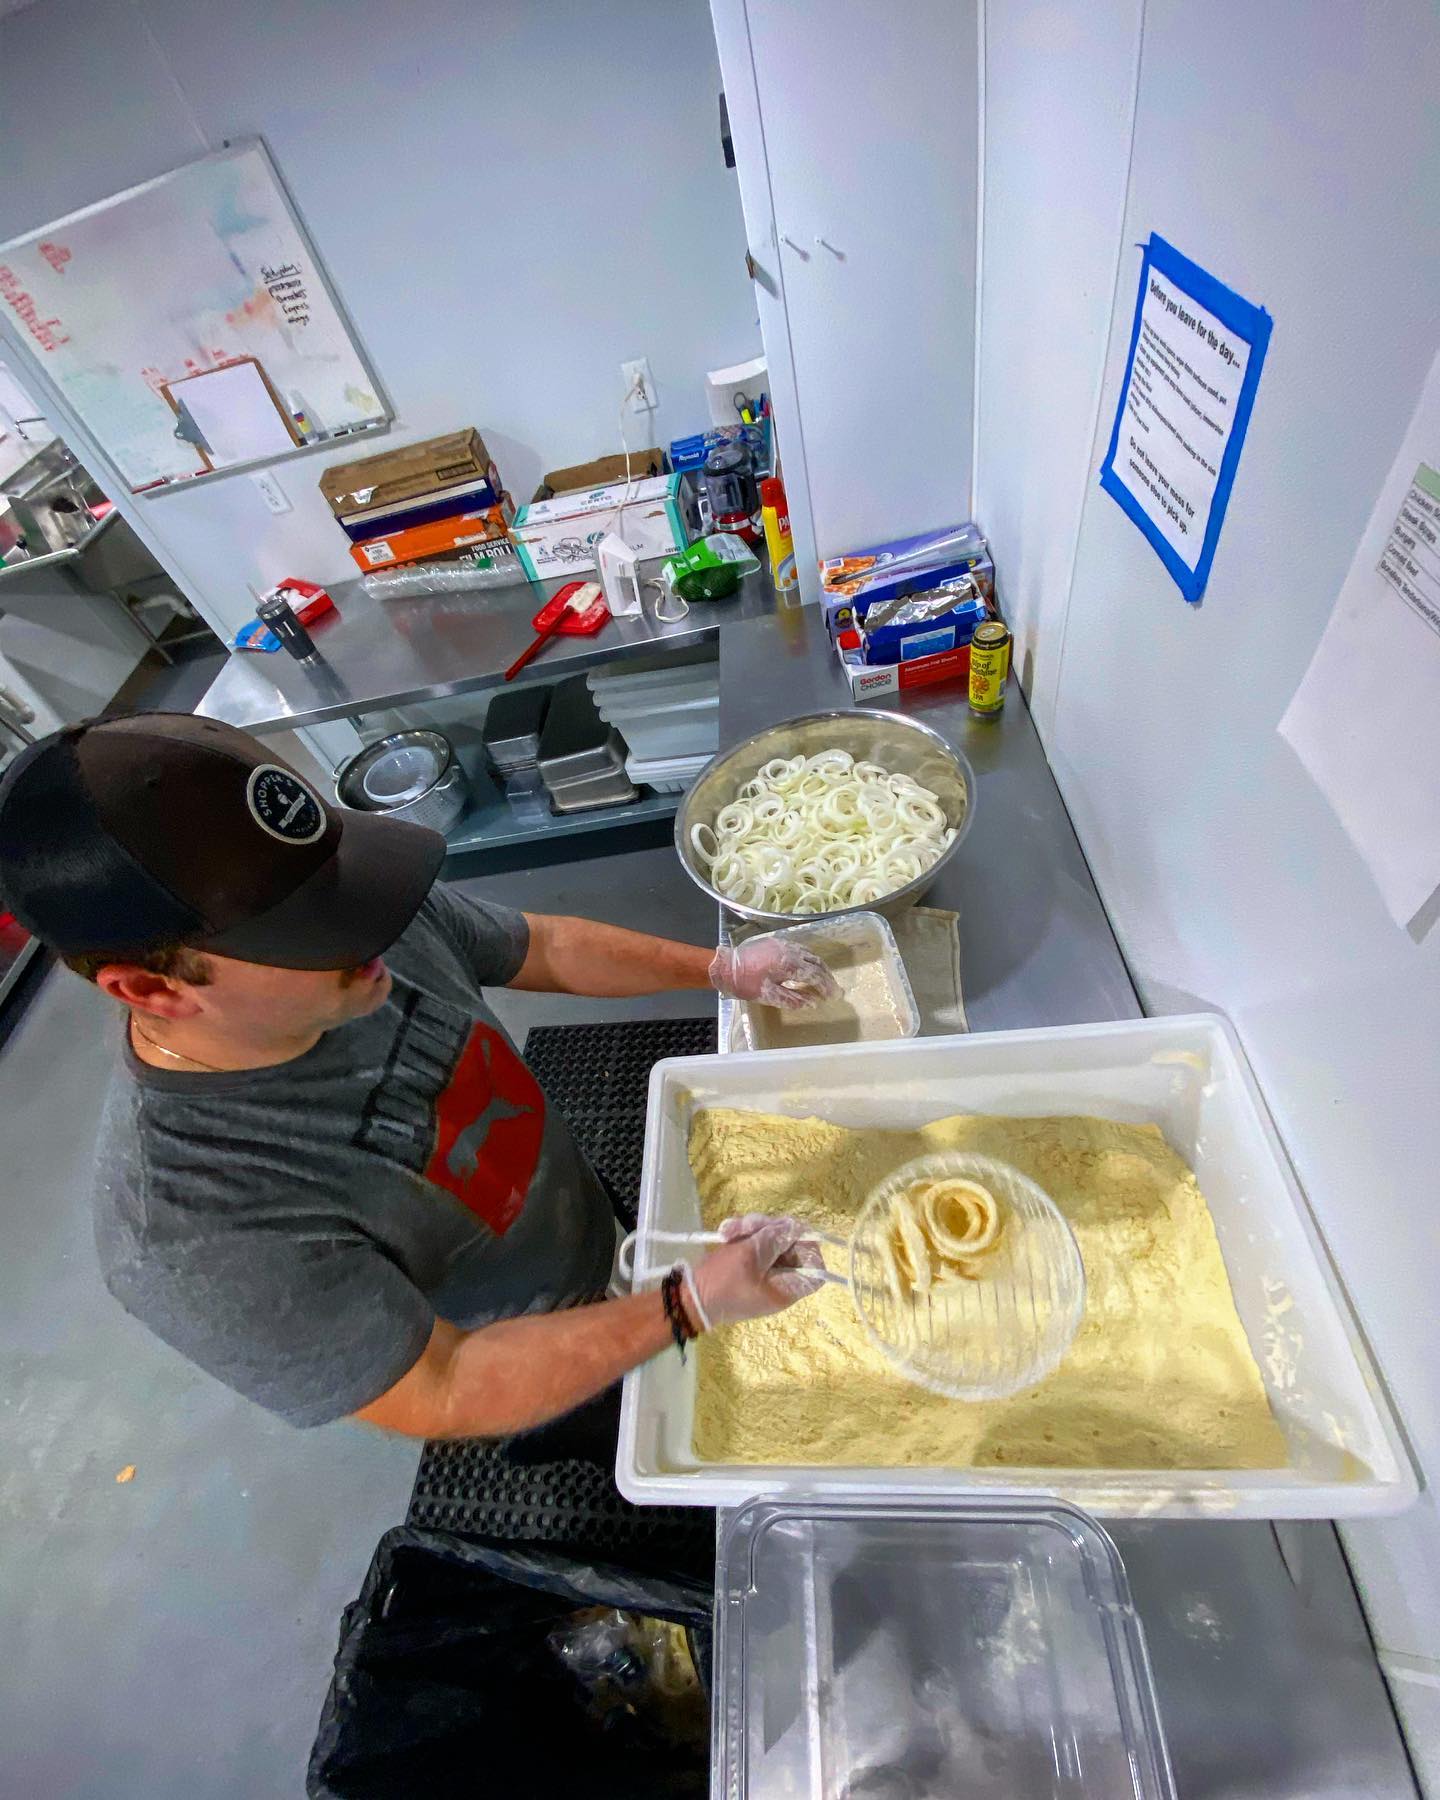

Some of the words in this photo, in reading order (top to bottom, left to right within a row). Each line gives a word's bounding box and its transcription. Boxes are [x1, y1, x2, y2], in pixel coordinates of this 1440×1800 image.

[1150, 279, 1166, 304] Before
[1165, 299, 1177, 315] you
[1178, 306, 1196, 330] leave
[1197, 321, 1207, 338] for
[1207, 330, 1218, 350] the
[860, 673, 892, 685] Gordon
